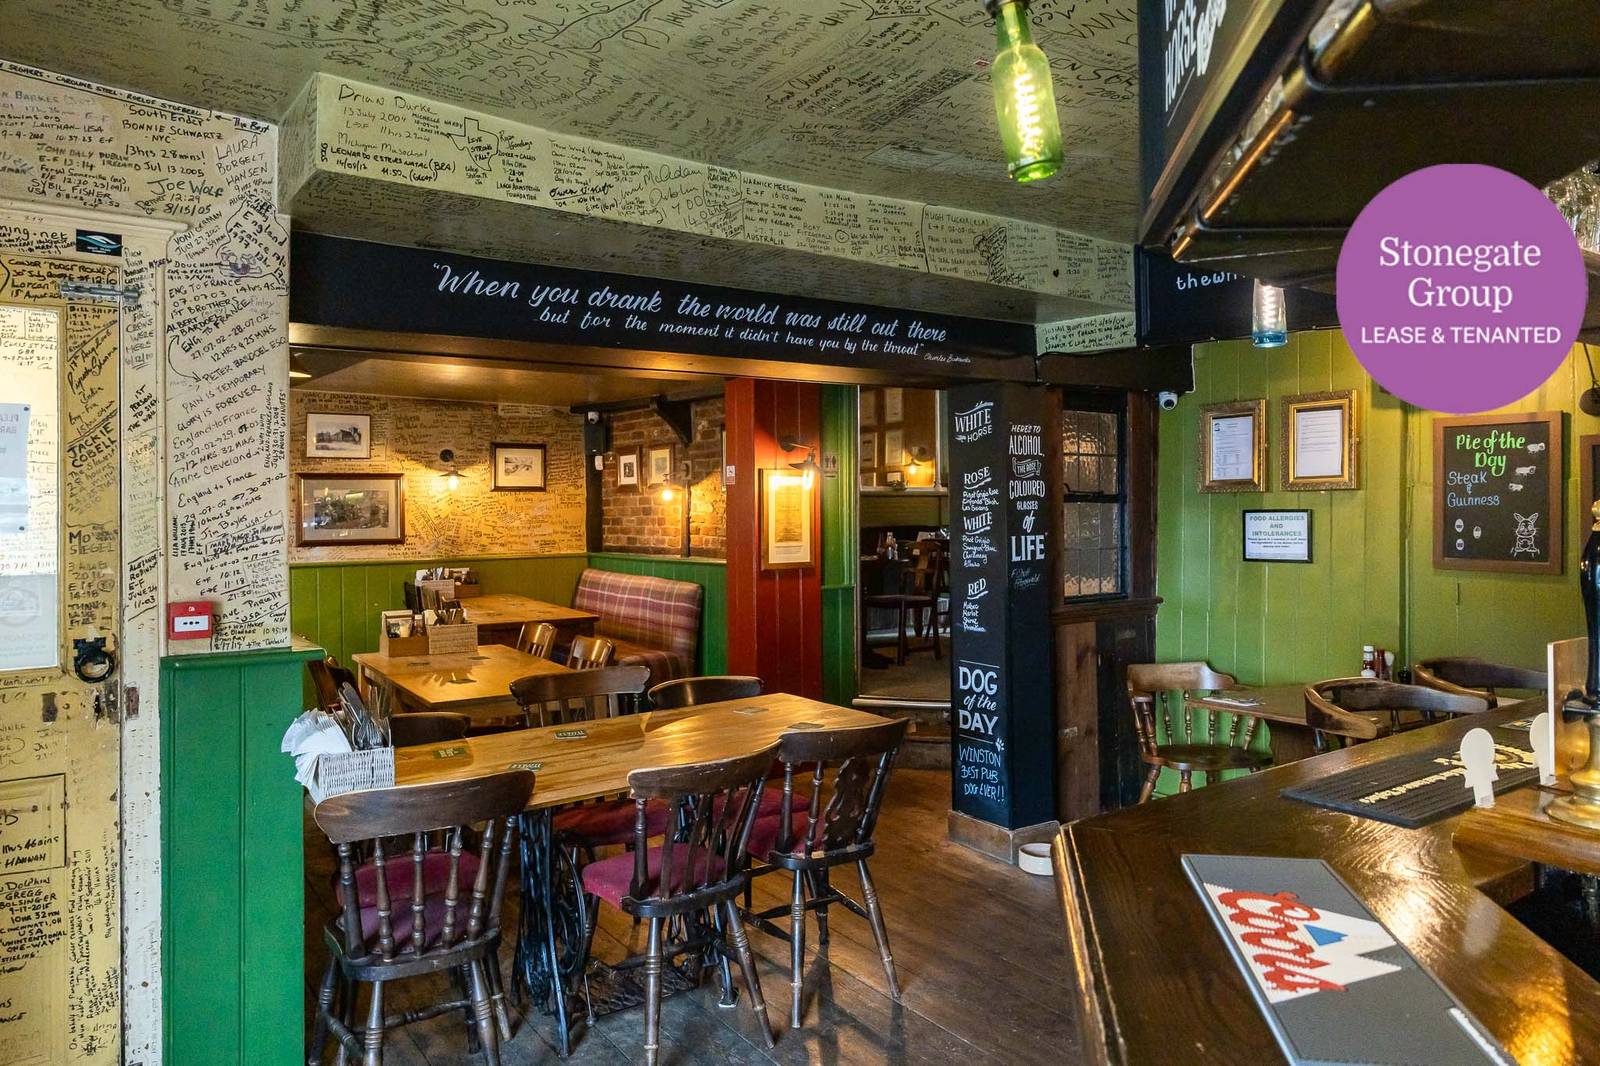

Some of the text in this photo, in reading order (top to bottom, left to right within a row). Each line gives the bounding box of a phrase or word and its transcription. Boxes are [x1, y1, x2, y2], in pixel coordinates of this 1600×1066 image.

[122, 119, 224, 140] BONNIE SCHWARTZ
[215, 134, 259, 161] LAURA
[143, 161, 161, 173] Jul
[225, 163, 268, 188] HANSEN
[31, 178, 113, 200] SYBIL FISHER
[146, 178, 186, 196] Joe
[746, 233, 785, 246] AUSTRALIA
[168, 285, 188, 299] ENG
[203, 279, 242, 290] FRANCE
[187, 296, 240, 315] BROTHERS
[528, 284, 579, 308] you
[588, 285, 663, 313] drank
[677, 292, 710, 319] the
[715, 303, 780, 326] world
[785, 311, 821, 329] was
[827, 313, 867, 334] still
[871, 319, 899, 338] out
[908, 321, 949, 342] there
[166, 316, 200, 334] ALBERT
[540, 307, 571, 325] but
[580, 312, 613, 330] for
[625, 314, 648, 331] the
[659, 321, 720, 339] moment
[724, 326, 735, 339] it
[785, 331, 814, 347] have
[819, 340, 841, 352] you
[844, 338, 858, 357] by
[861, 340, 879, 353] the
[182, 396, 204, 414] PAIN
[216, 364, 266, 394] TEMPORARY
[177, 412, 204, 432] GLORY
[215, 384, 261, 412] FOREVER
[954, 408, 992, 433] WHITE
[1032, 425, 1041, 433] TO
[66, 421, 114, 459] JACKIE
[967, 424, 993, 443] HORSE
[1456, 429, 1526, 455] Pie of the
[71, 437, 118, 468] COBELL
[1474, 452, 1507, 477] Day
[963, 466, 991, 485] ROSE
[1447, 470, 1488, 486] Steak
[177, 488, 212, 508] England
[225, 471, 257, 486] France
[1008, 479, 1046, 500] COLOURED
[1016, 500, 1039, 511] GLASSES
[1447, 492, 1500, 508] Guinness
[963, 511, 993, 531] WHITE
[1022, 510, 1036, 533] of
[201, 527, 219, 541] Jim
[967, 577, 987, 597] RED
[958, 666, 998, 696] DOG
[963, 693, 997, 712] of the
[958, 709, 999, 736] DAY
[959, 744, 1001, 768] WINSTON
[981, 766, 999, 784] PUB
[5, 889, 43, 901] GREGG
[18, 928, 44, 937] USA
